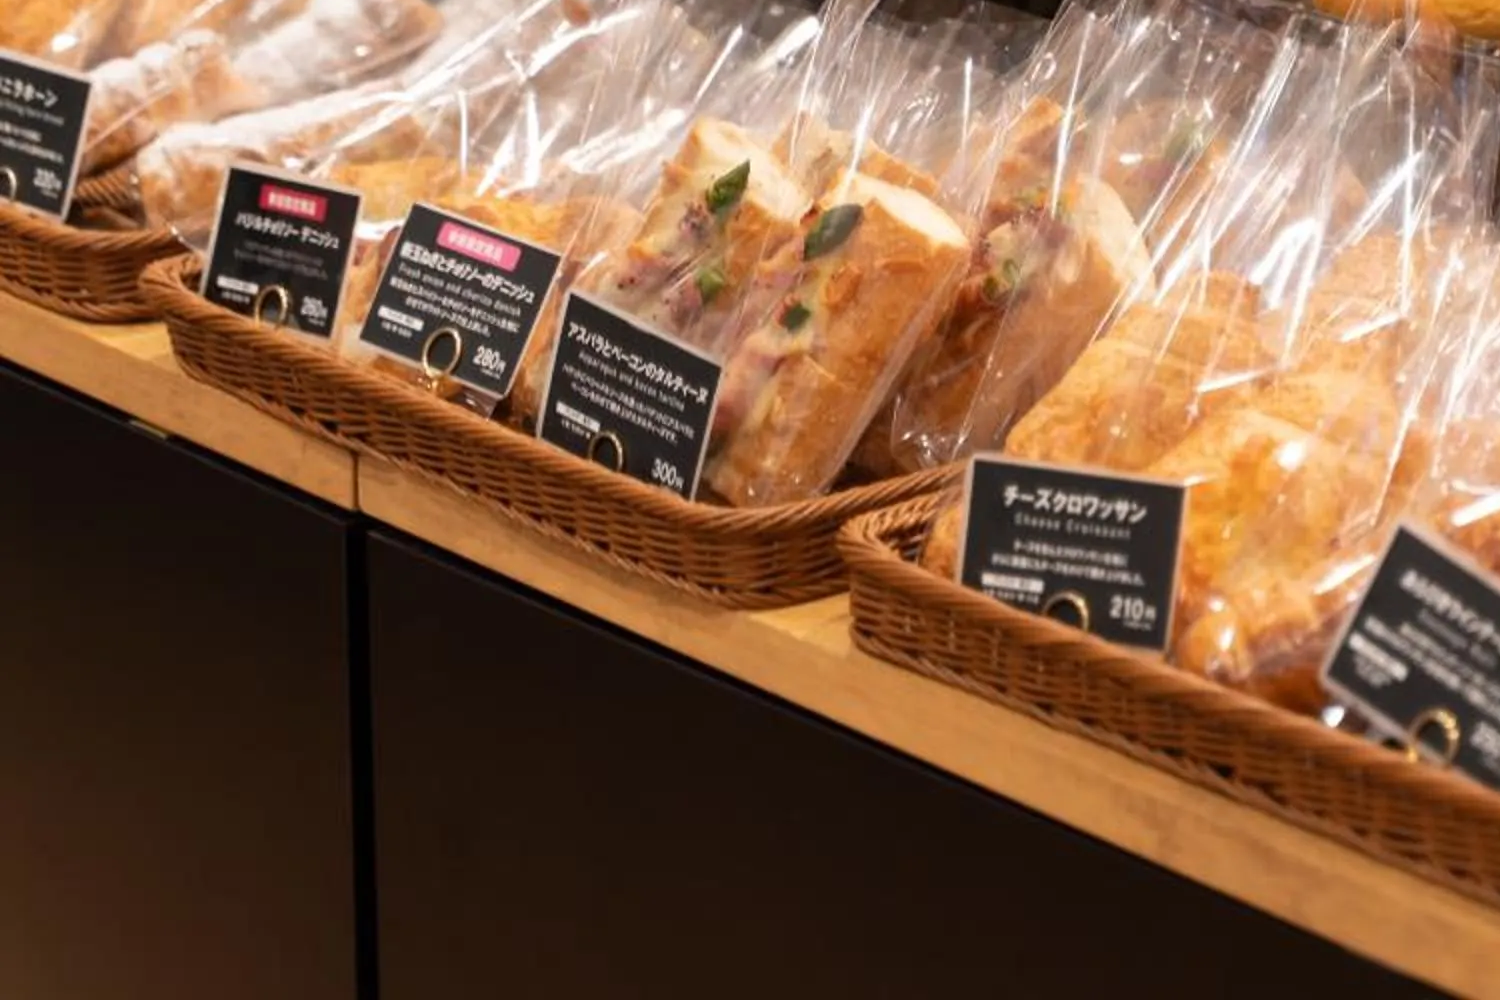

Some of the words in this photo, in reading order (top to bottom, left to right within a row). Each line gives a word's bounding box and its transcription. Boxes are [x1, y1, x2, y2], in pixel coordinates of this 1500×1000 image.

[0, 77, 58, 107] ニラホーン
[567, 321, 708, 405] アスパラとベーコンのタルティーヌ
[651, 457, 684, 489] 300円
[1003, 484, 1147, 524] チーズクロワッサン
[1109, 594, 1156, 620] 210円
